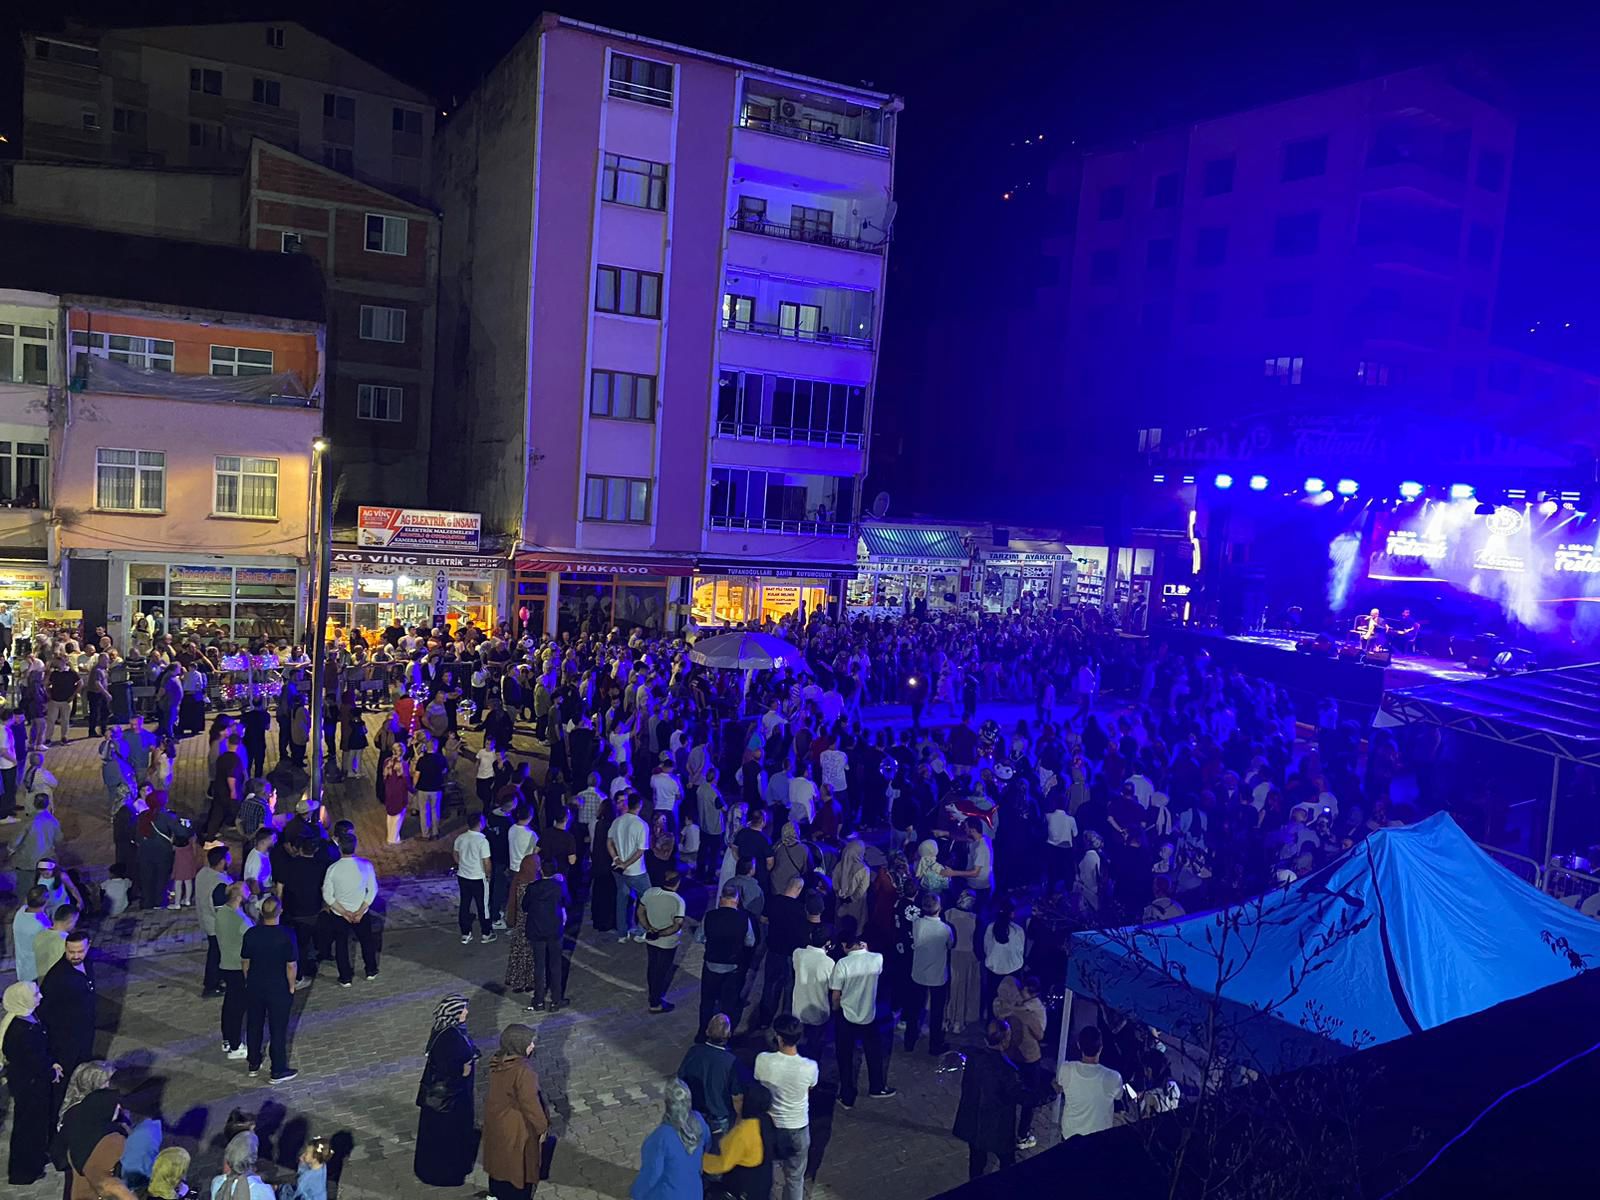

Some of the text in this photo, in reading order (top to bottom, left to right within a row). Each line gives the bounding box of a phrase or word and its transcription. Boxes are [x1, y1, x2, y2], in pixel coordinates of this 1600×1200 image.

[400, 514, 410, 525] AG
[412, 514, 446, 526] ELEKTRİK
[368, 554, 418, 564] VİNÇ
[426, 558, 463, 566] ELEKTRİK
[576, 565, 648, 574] HAKALOO
